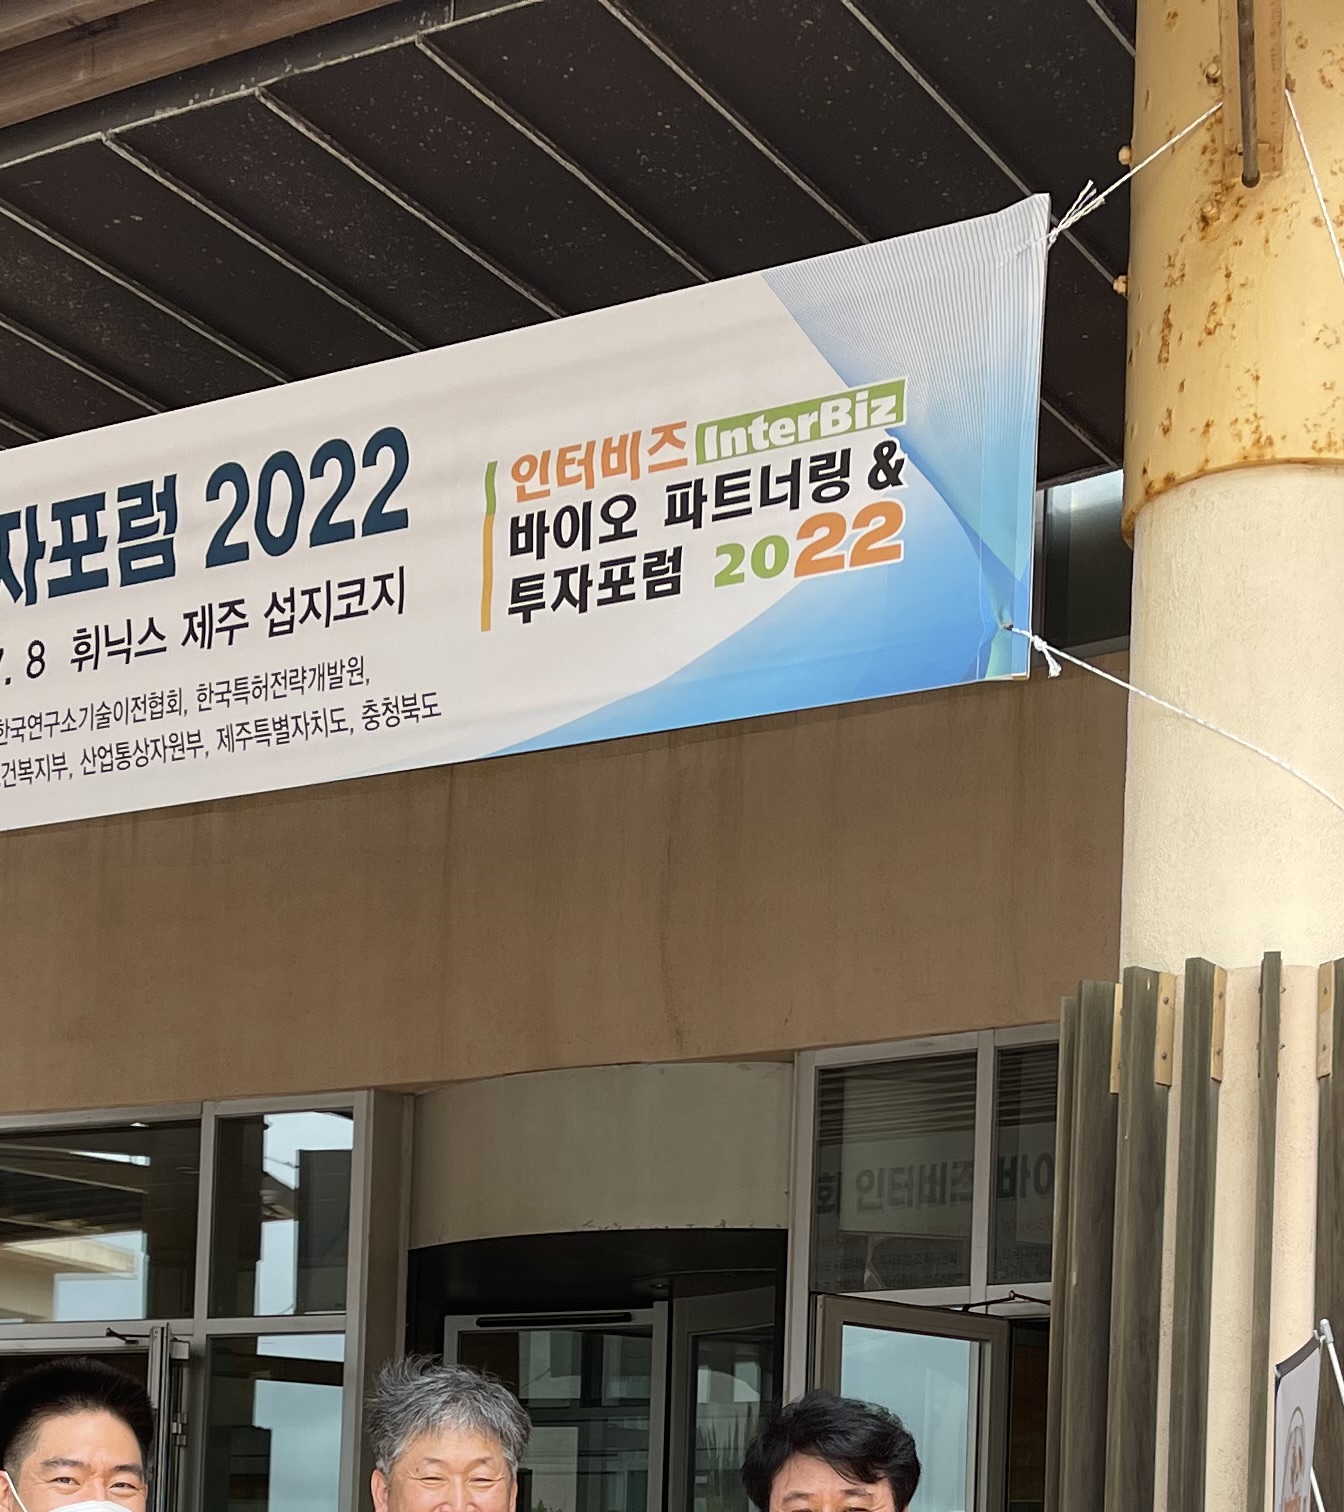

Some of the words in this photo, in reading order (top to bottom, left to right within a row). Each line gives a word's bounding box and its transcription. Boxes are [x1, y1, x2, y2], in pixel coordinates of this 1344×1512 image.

[204, 426, 410, 570] 2022
[509, 494, 638, 560] 바이오
[663, 447, 852, 530] 파트너링
[867, 440, 905, 491] &
[510, 420, 689, 503] 인터비즈
[703, 390, 898, 462] InterBiz
[507, 546, 683, 624] 투자포럼
[713, 501, 905, 588] 2022
[25, 639, 46, 679] 8
[70, 616, 167, 673] 휘닉스
[181, 598, 249, 651] 제주
[263, 565, 406, 638] 섭지코지
[80, 730, 209, 777] 산업통상자원부,
[216, 706, 354, 752] 제주특별자치도,
[361, 691, 442, 732] 충청북도
